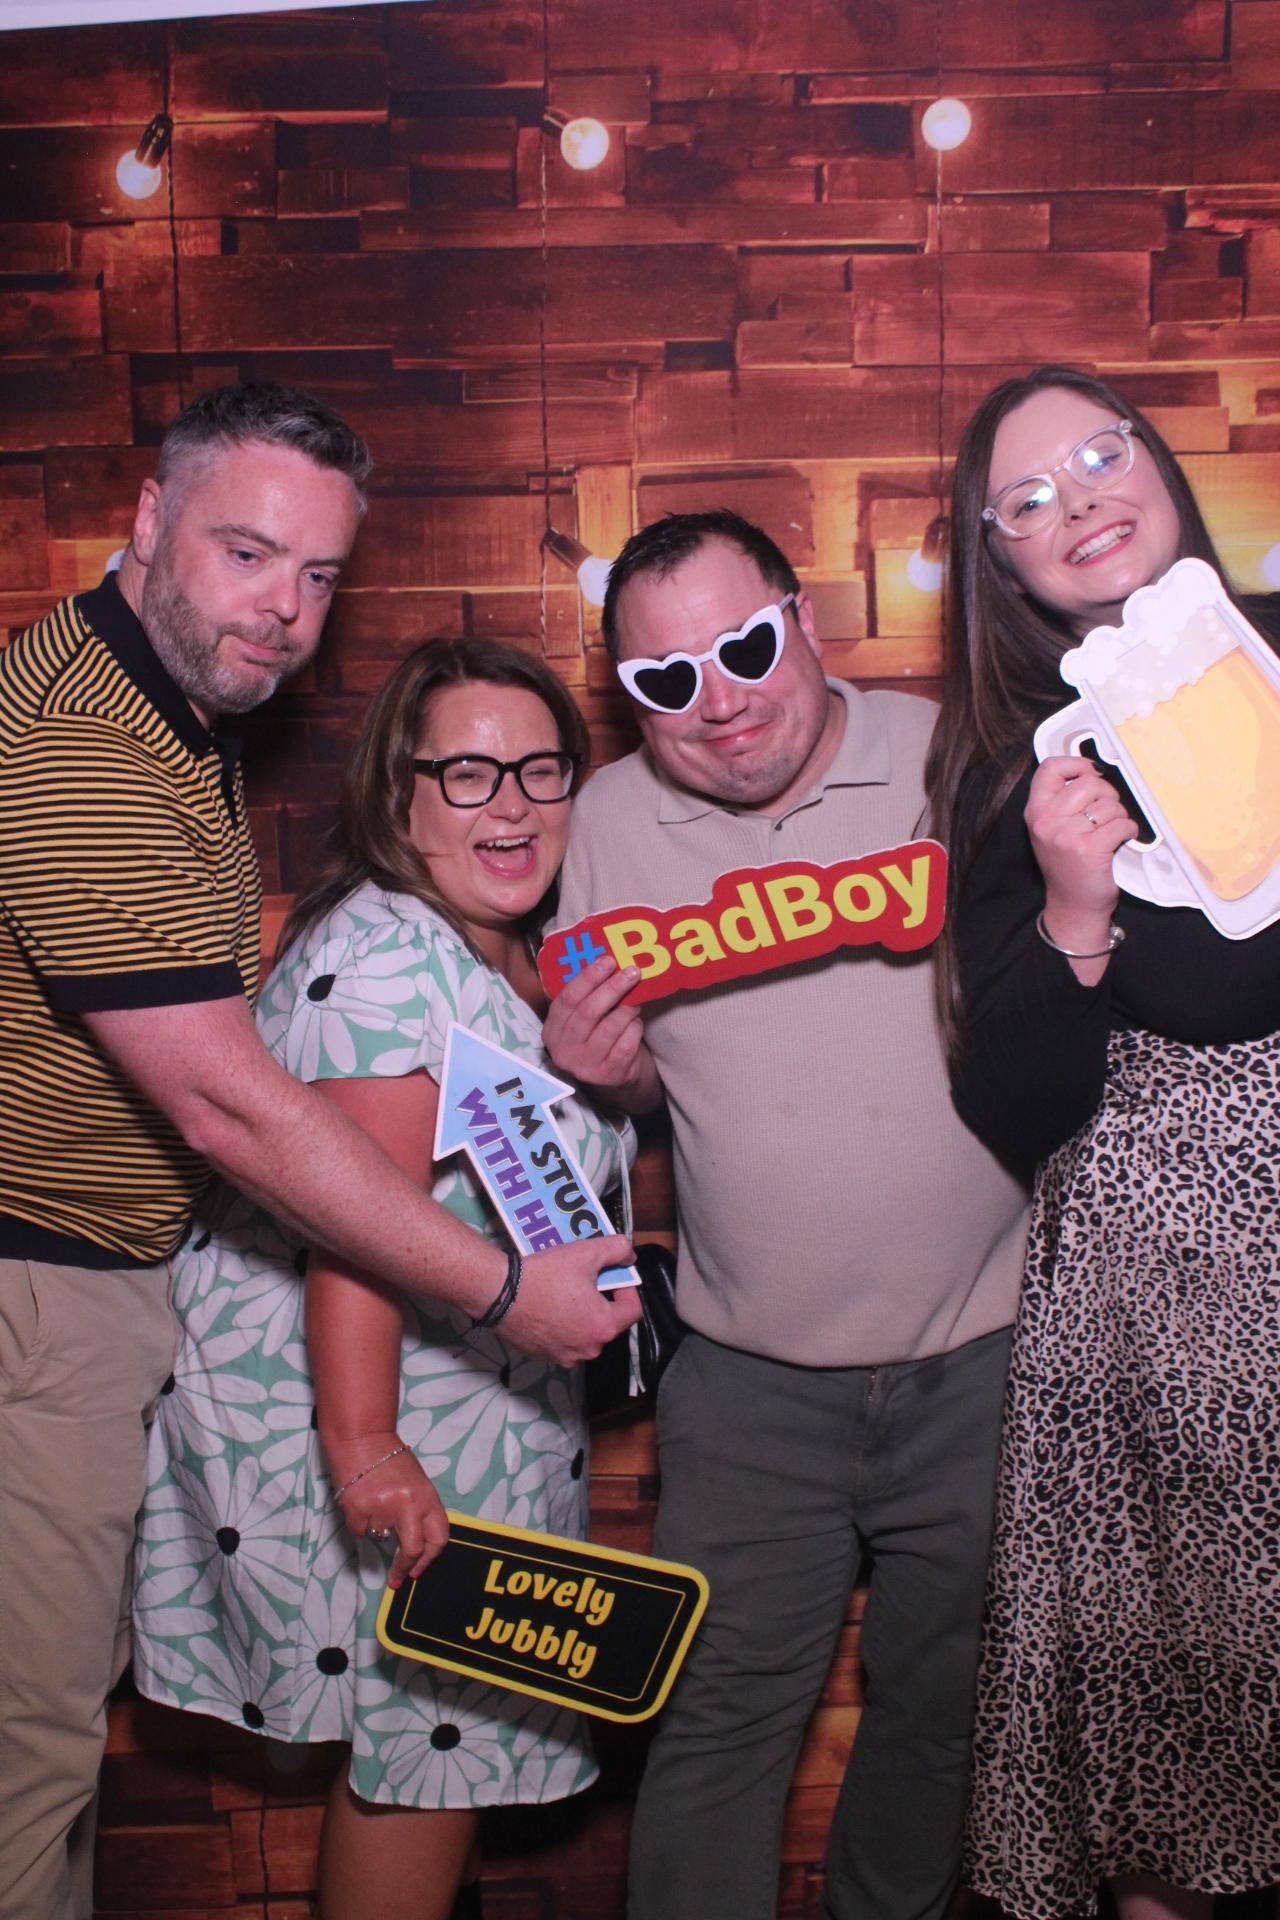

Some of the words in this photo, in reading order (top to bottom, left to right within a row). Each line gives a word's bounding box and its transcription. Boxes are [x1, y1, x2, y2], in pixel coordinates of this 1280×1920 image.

[558, 855, 930, 983] #BadBoy
[456, 1087, 533, 1201] WITH
[513, 1198, 565, 1254] HE
[494, 1076, 544, 1141] I'M
[530, 1141, 605, 1240] STUC
[465, 1607, 598, 1680] Jubbly
[484, 1560, 616, 1626] Lovely
